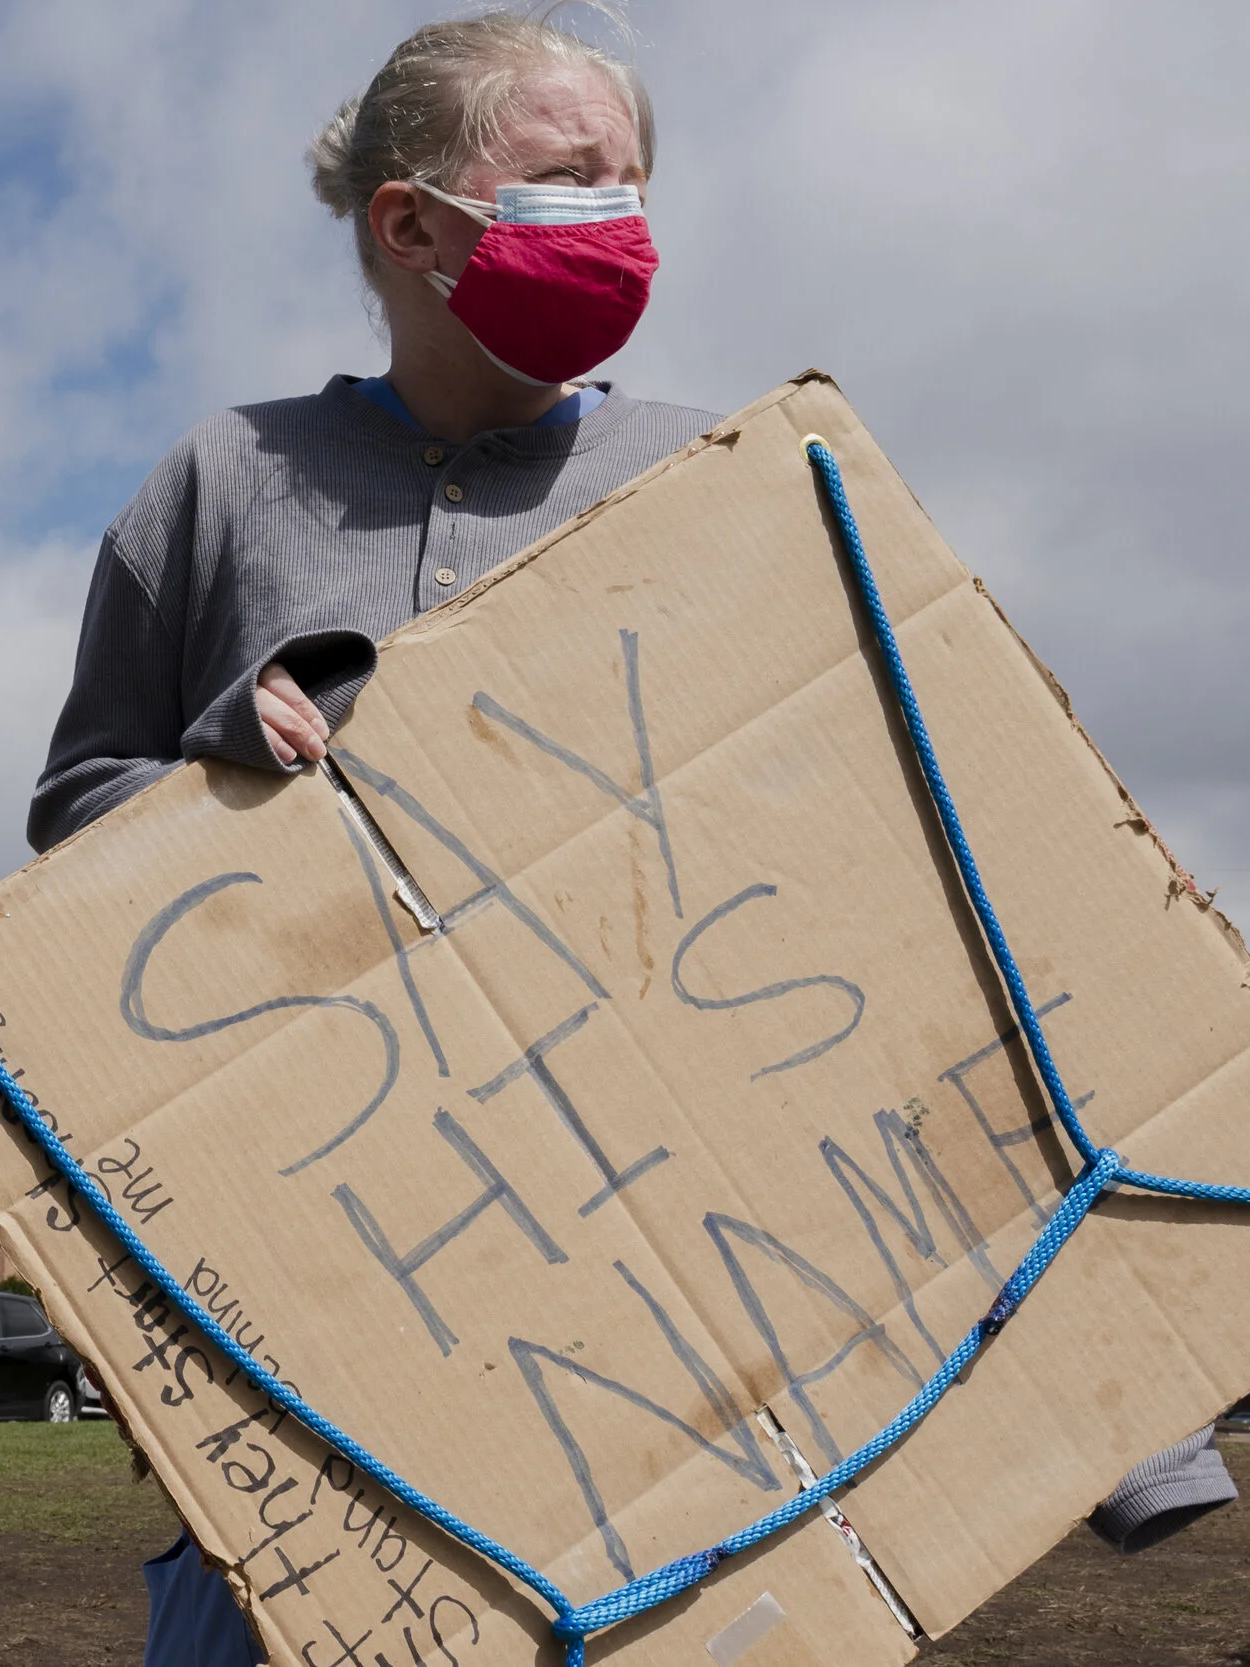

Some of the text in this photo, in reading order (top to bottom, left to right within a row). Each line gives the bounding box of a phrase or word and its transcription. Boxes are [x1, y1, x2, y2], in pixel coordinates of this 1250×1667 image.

[120, 629, 683, 1177] SAY
[330, 884, 865, 1357] HIS
[98, 1138, 174, 1225] me
[507, 992, 1129, 1583] NAME
[195, 1408, 341, 1601] they
